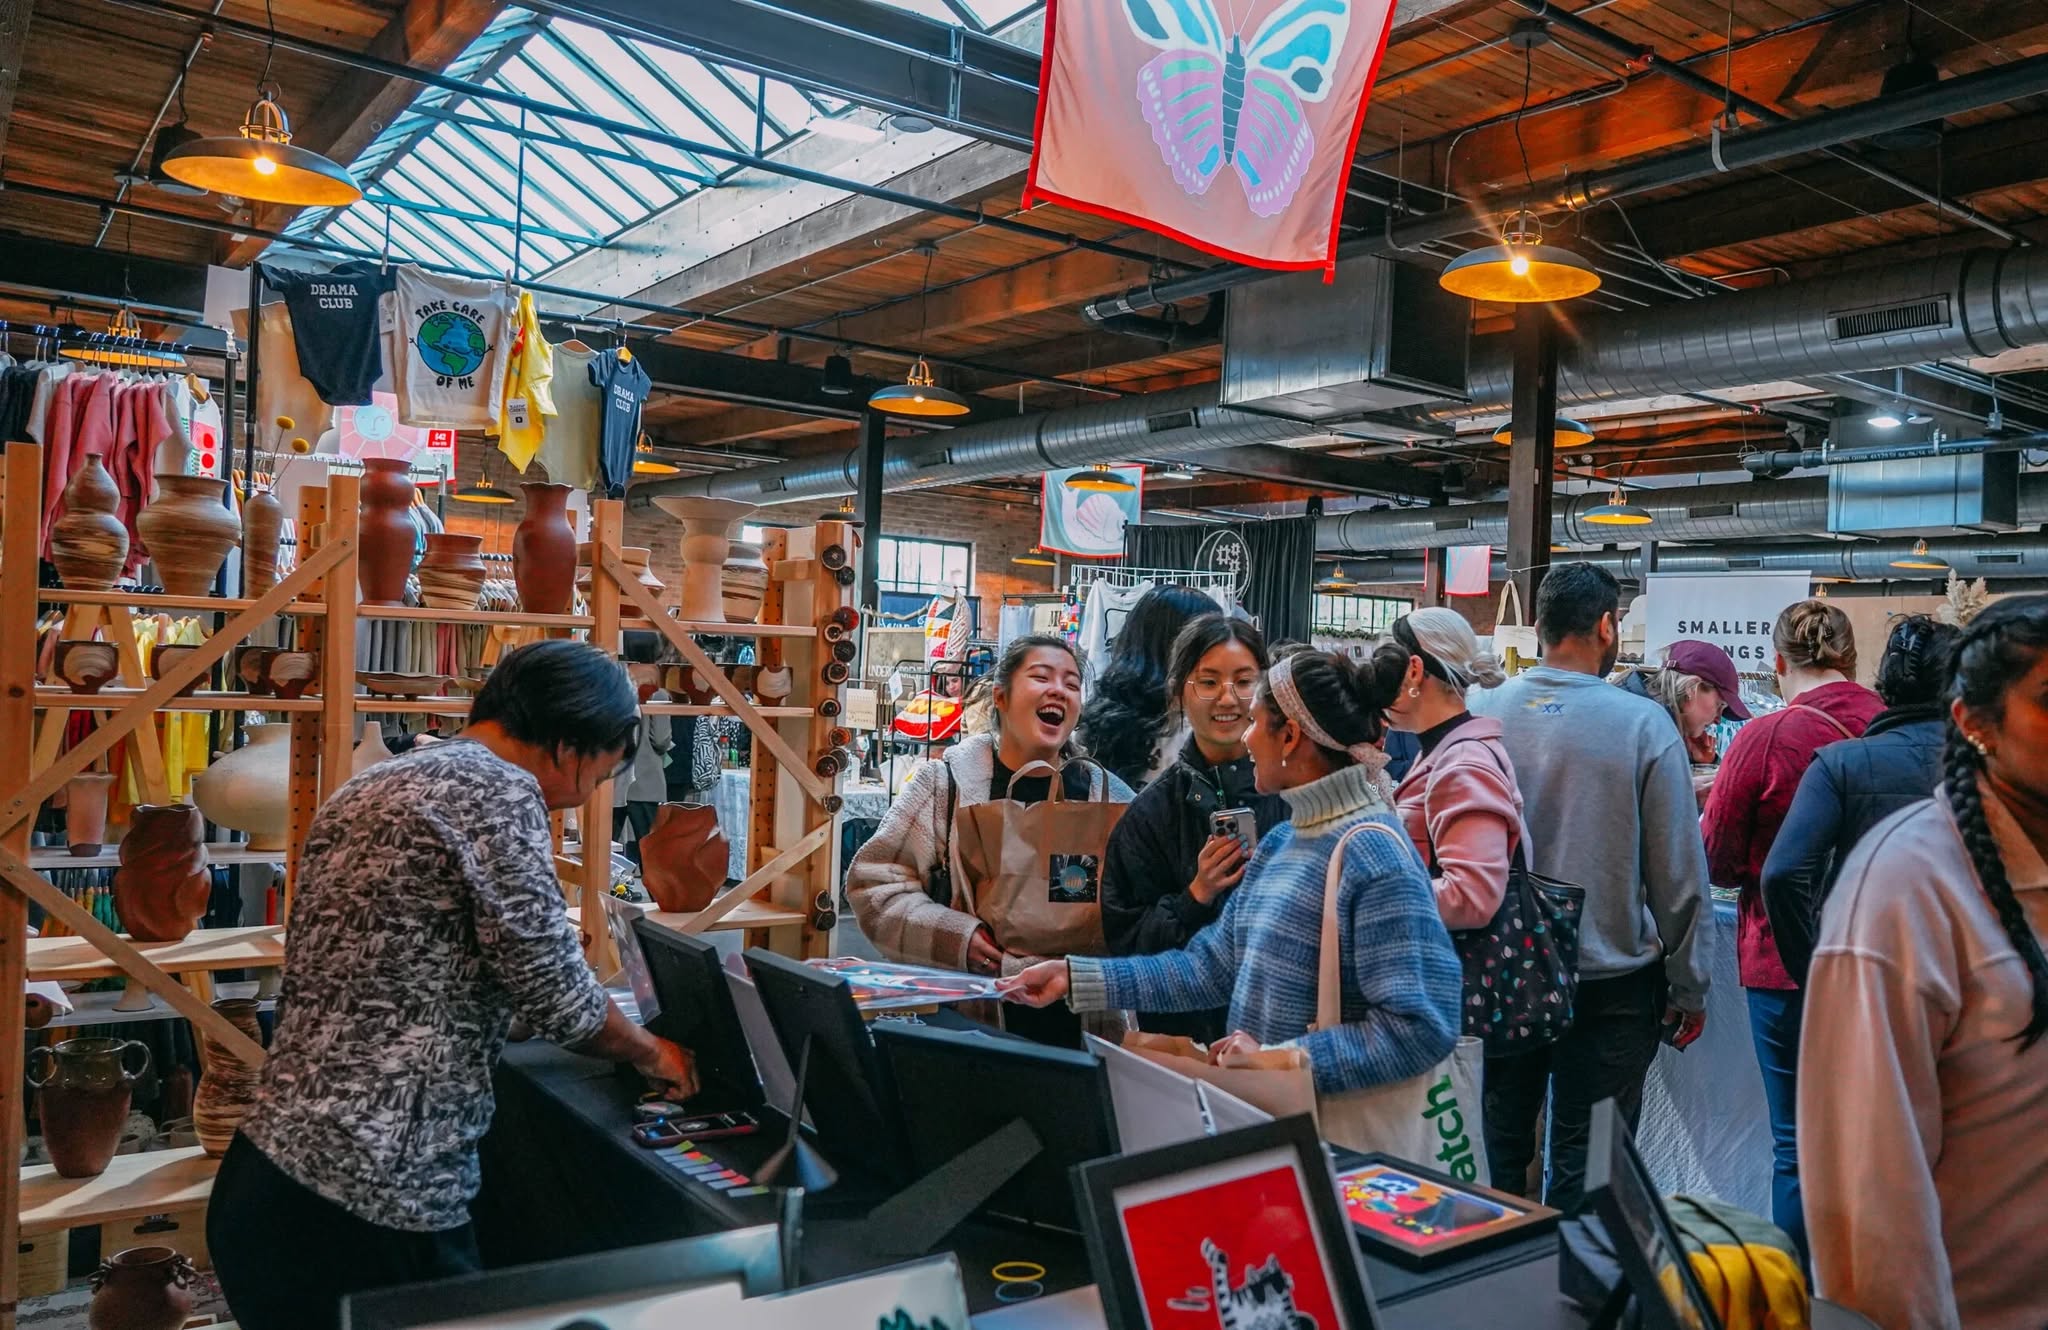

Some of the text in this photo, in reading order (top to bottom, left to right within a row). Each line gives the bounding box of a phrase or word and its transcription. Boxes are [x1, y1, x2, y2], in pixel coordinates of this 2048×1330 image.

[310, 283, 359, 296] DRAMA
[319, 297, 353, 309] CLUB
[415, 300, 447, 320] TAKE
[452, 301, 485, 324] CARE
[436, 376, 475, 390] OF ME
[613, 383, 635, 403] DRAMA
[615, 398, 631, 413] CLUB
[1677, 620, 1771, 635] SMALLER
[868, 664, 924, 680] UNDERCRRENT
